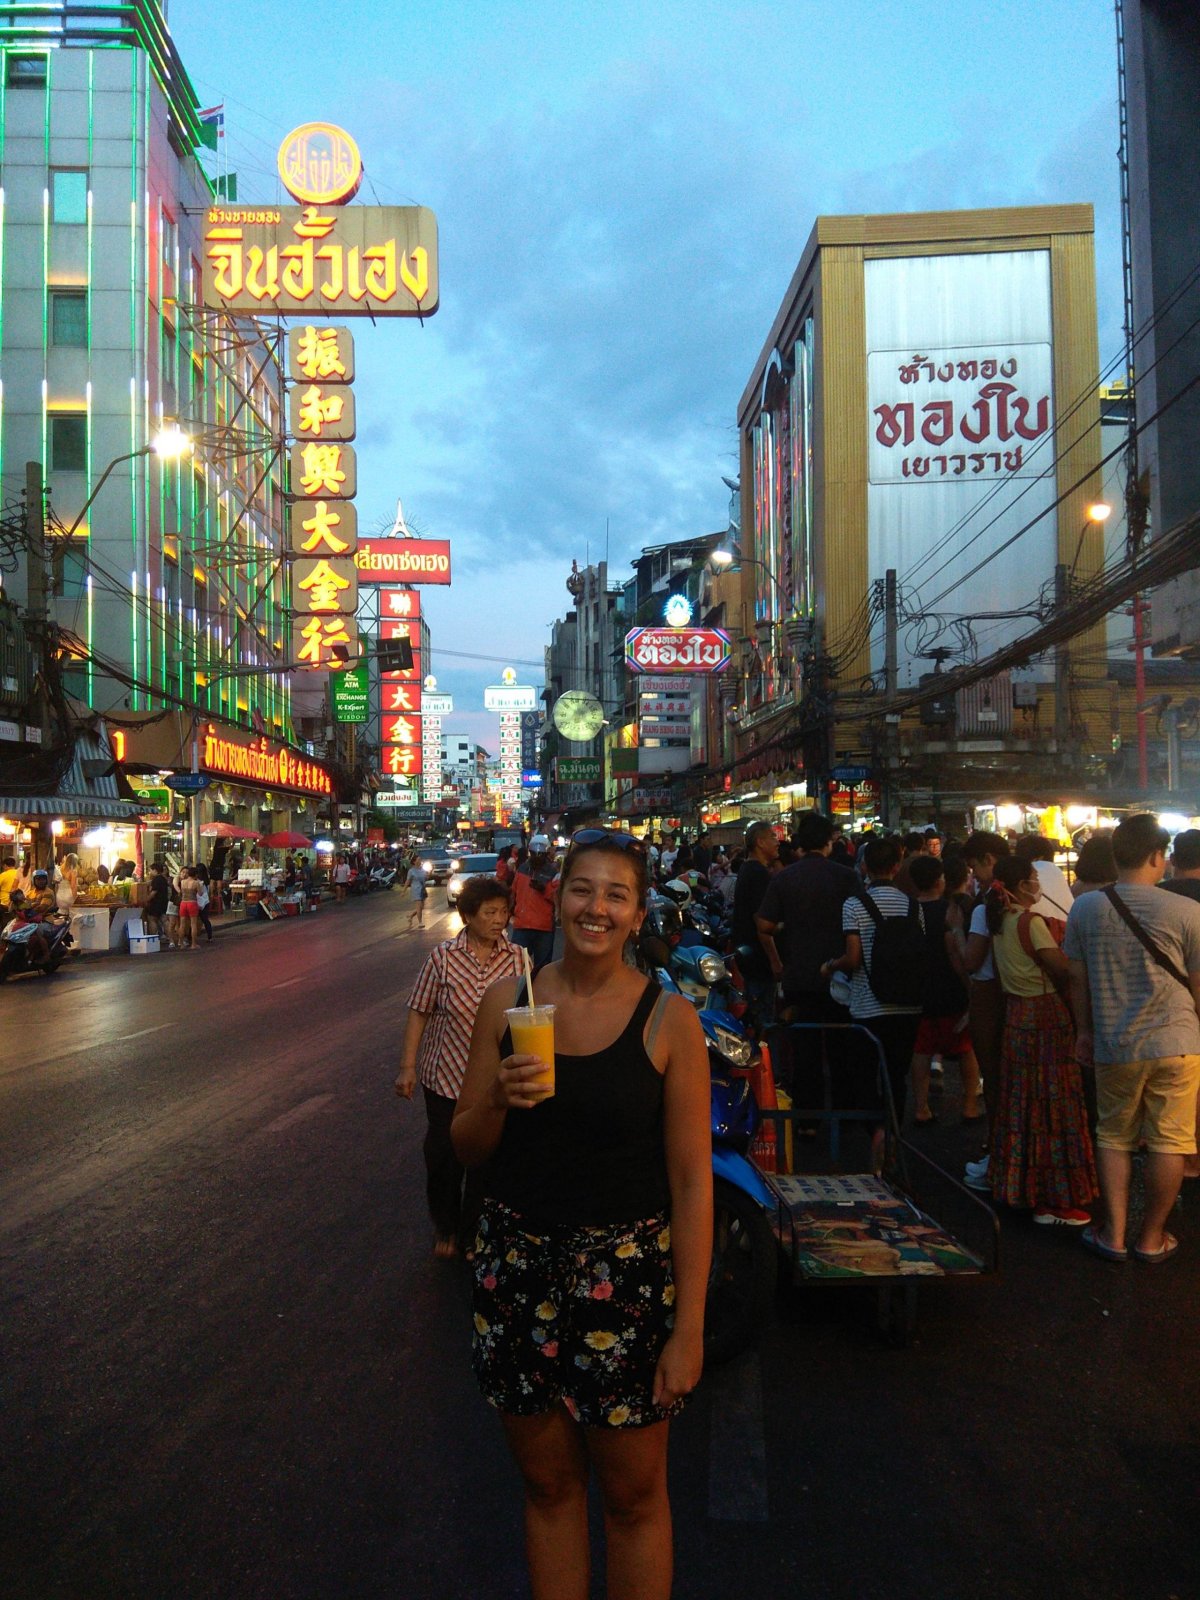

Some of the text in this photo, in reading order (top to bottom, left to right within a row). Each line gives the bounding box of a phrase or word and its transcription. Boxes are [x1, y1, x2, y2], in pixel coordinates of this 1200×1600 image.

[208, 207, 281, 225] ห้างขายทอง
[205, 206, 430, 303] จินฮั้วเฮง
[898, 354, 1018, 385] ห้างทอง
[873, 382, 1050, 448] ทองใบ
[902, 445, 1023, 478] เยาวราช
[296, 325, 351, 669] 振和興大金行
[636, 635, 721, 665] ทองใบ
[642, 632, 683, 645] ห้างทอง
